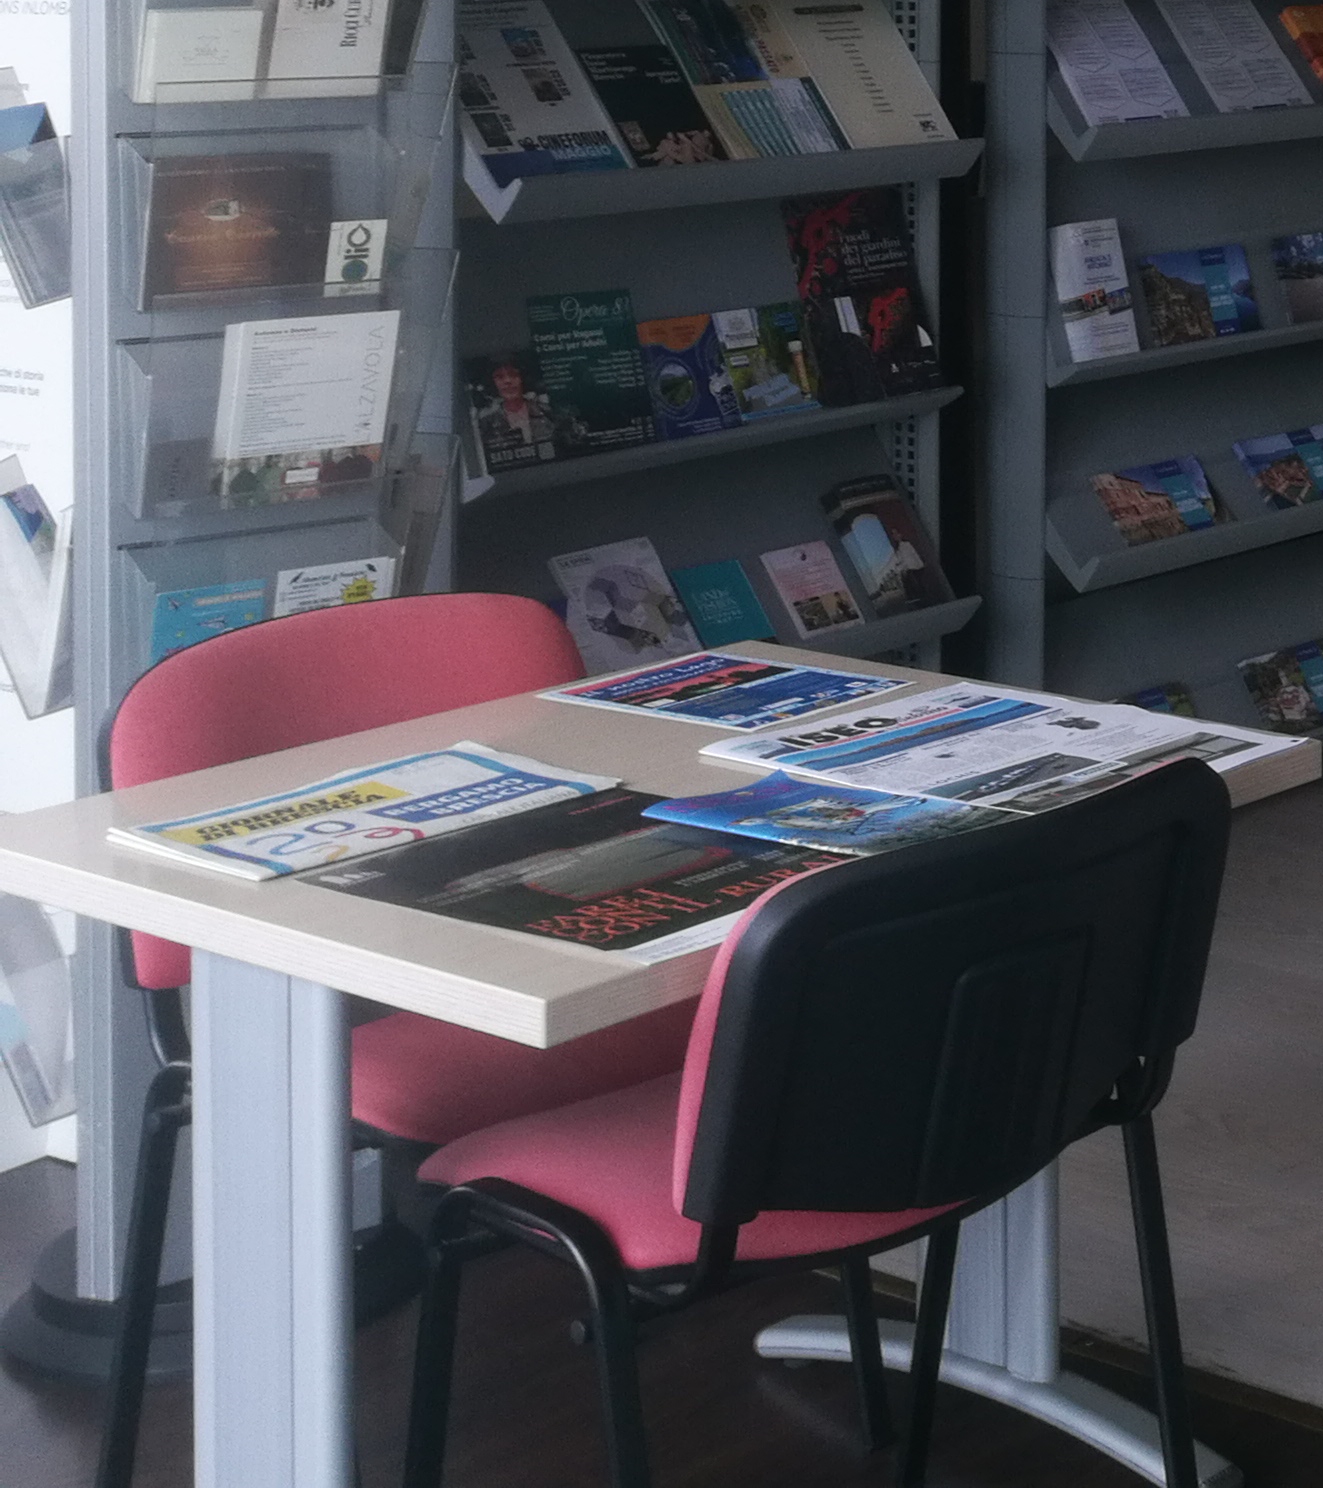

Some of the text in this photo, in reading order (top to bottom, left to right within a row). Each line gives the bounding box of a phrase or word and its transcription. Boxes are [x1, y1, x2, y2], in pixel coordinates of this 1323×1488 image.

[778, 716, 898, 747] ISEO
[384, 776, 524, 821] BERGAMO
[430, 780, 546, 817] BRESCIA
